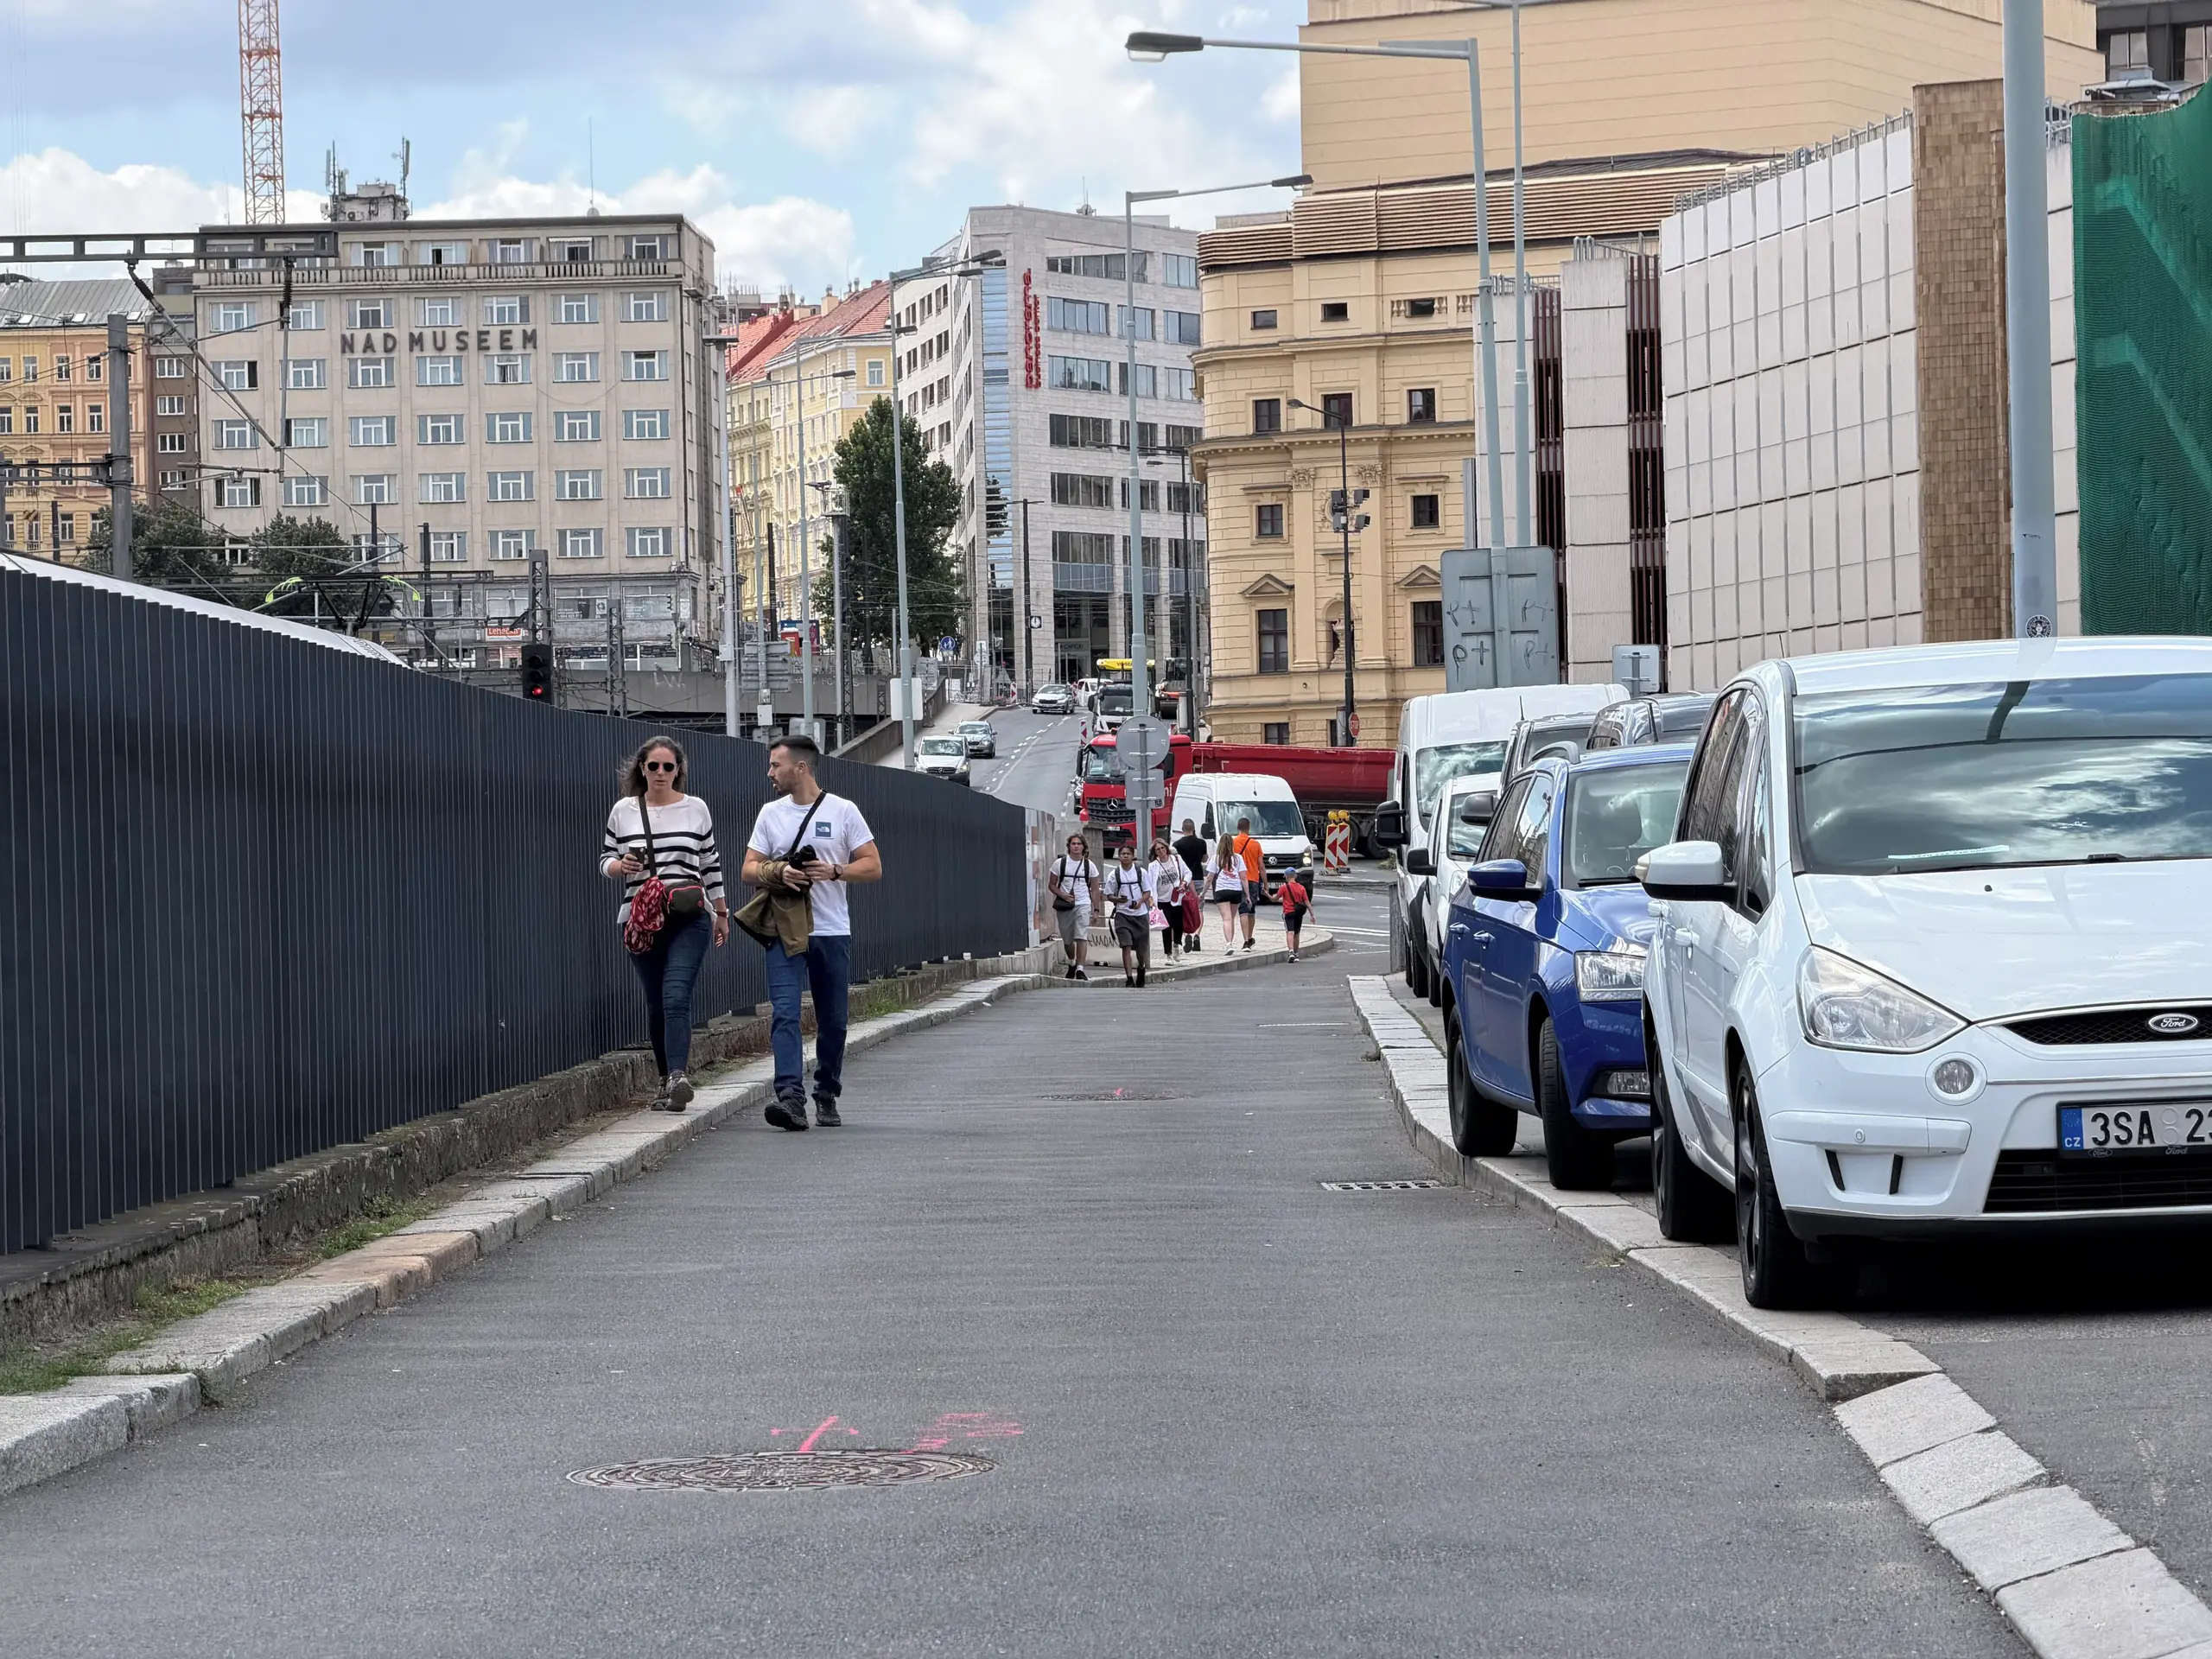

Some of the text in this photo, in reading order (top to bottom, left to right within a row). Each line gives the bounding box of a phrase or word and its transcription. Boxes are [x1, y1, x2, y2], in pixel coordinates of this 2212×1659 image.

[340, 328, 537, 354] NAD MUSEEM
[2160, 1017, 2186, 1027] Ford
[2091, 1108, 2212, 1146] 3SA 2
[2064, 1137, 2081, 1147] CZ
[2165, 1145, 2188, 1154] Ford
